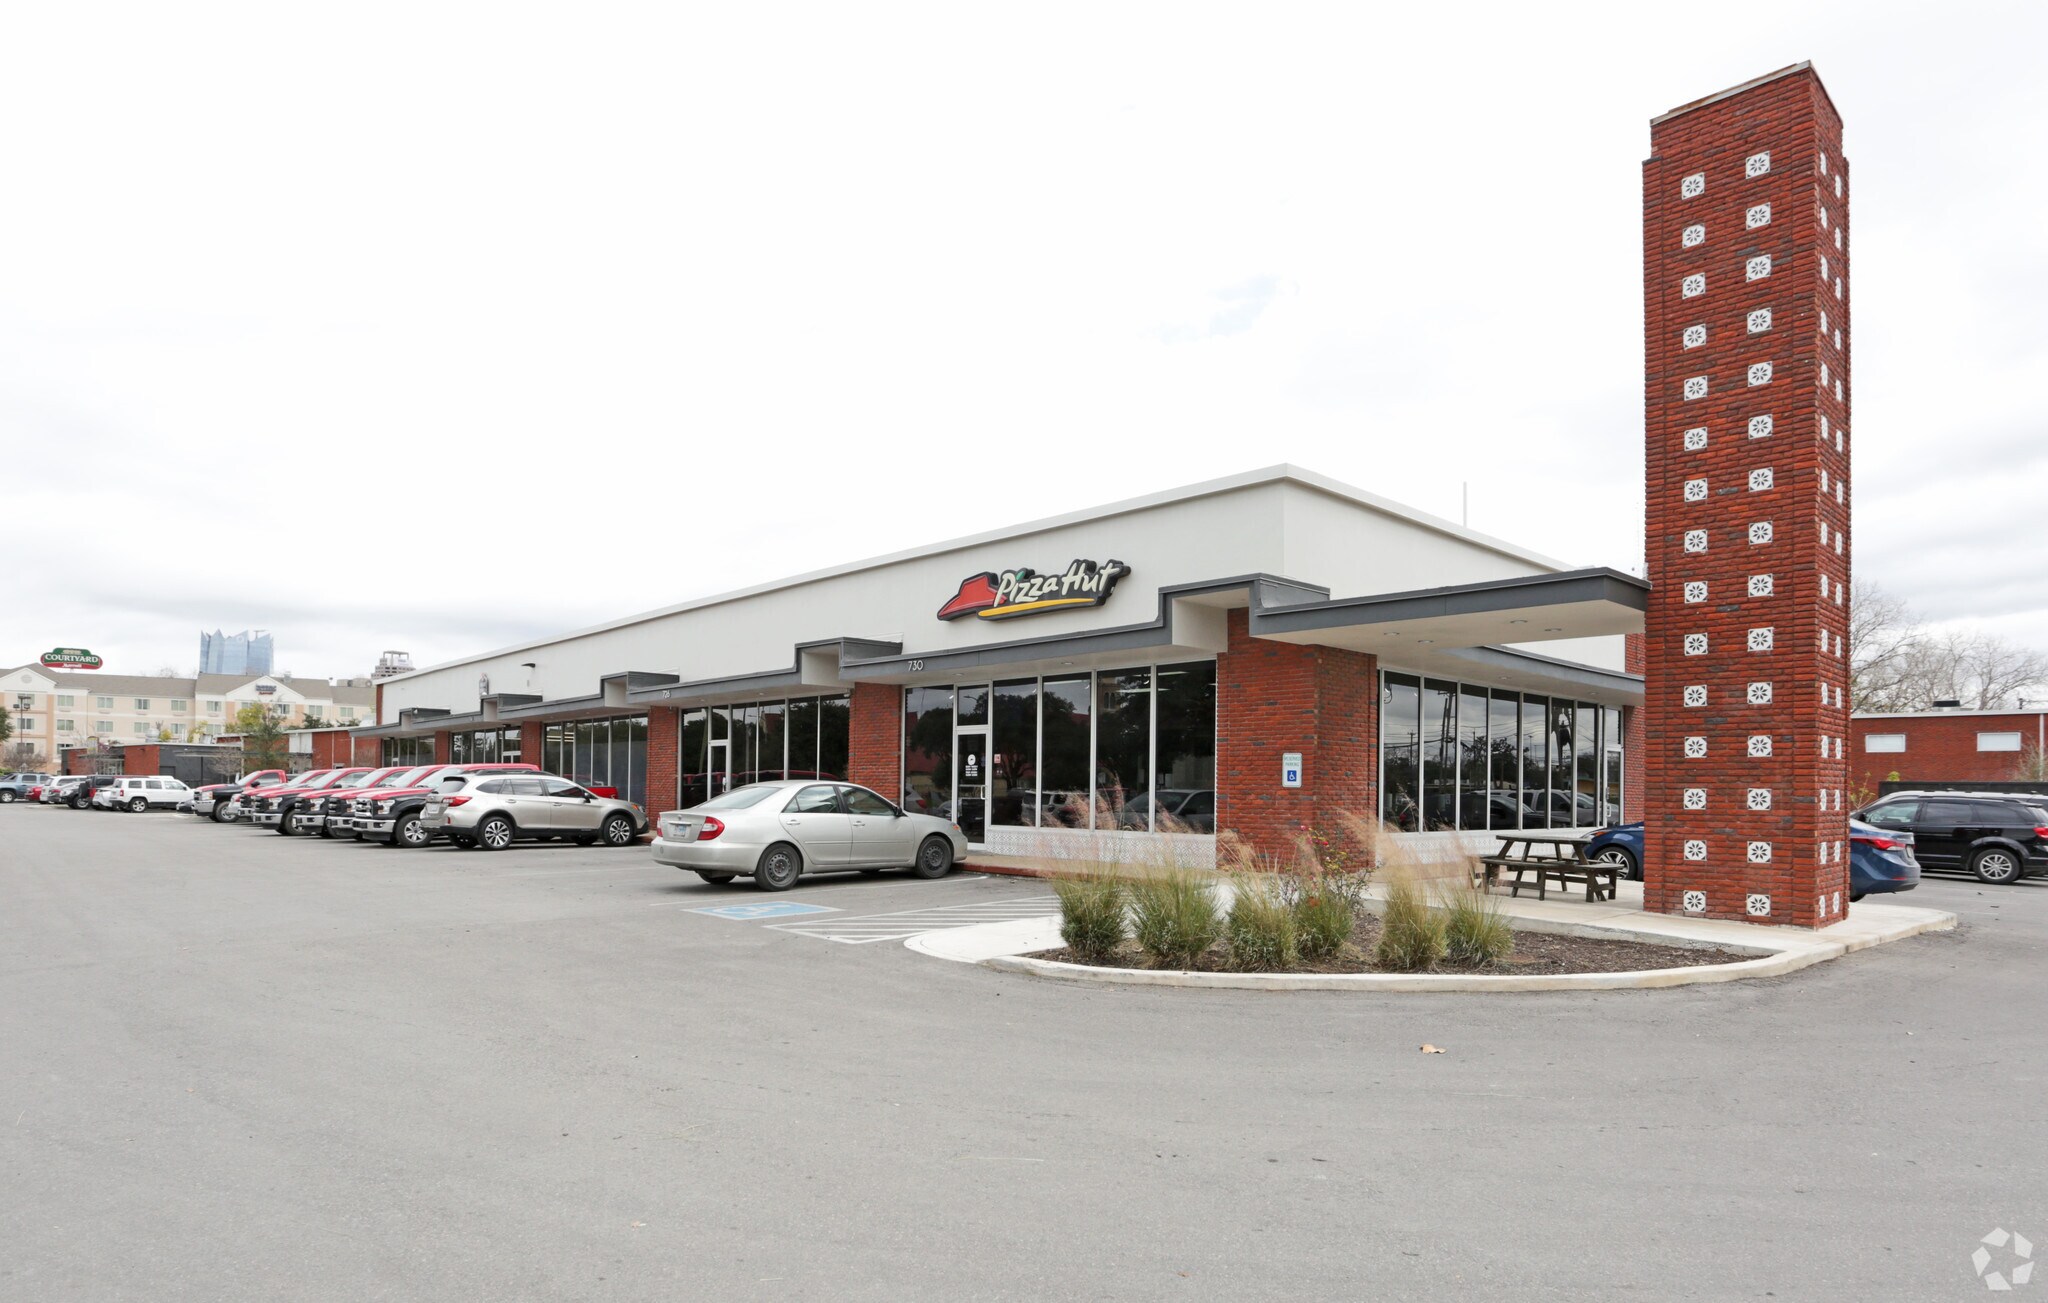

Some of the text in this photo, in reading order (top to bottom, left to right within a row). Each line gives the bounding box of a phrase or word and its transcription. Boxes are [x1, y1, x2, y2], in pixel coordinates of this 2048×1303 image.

[993, 562, 1120, 607] Pizza Hut
[45, 653, 99, 663] COURTYARD
[908, 660, 924, 671] 730
